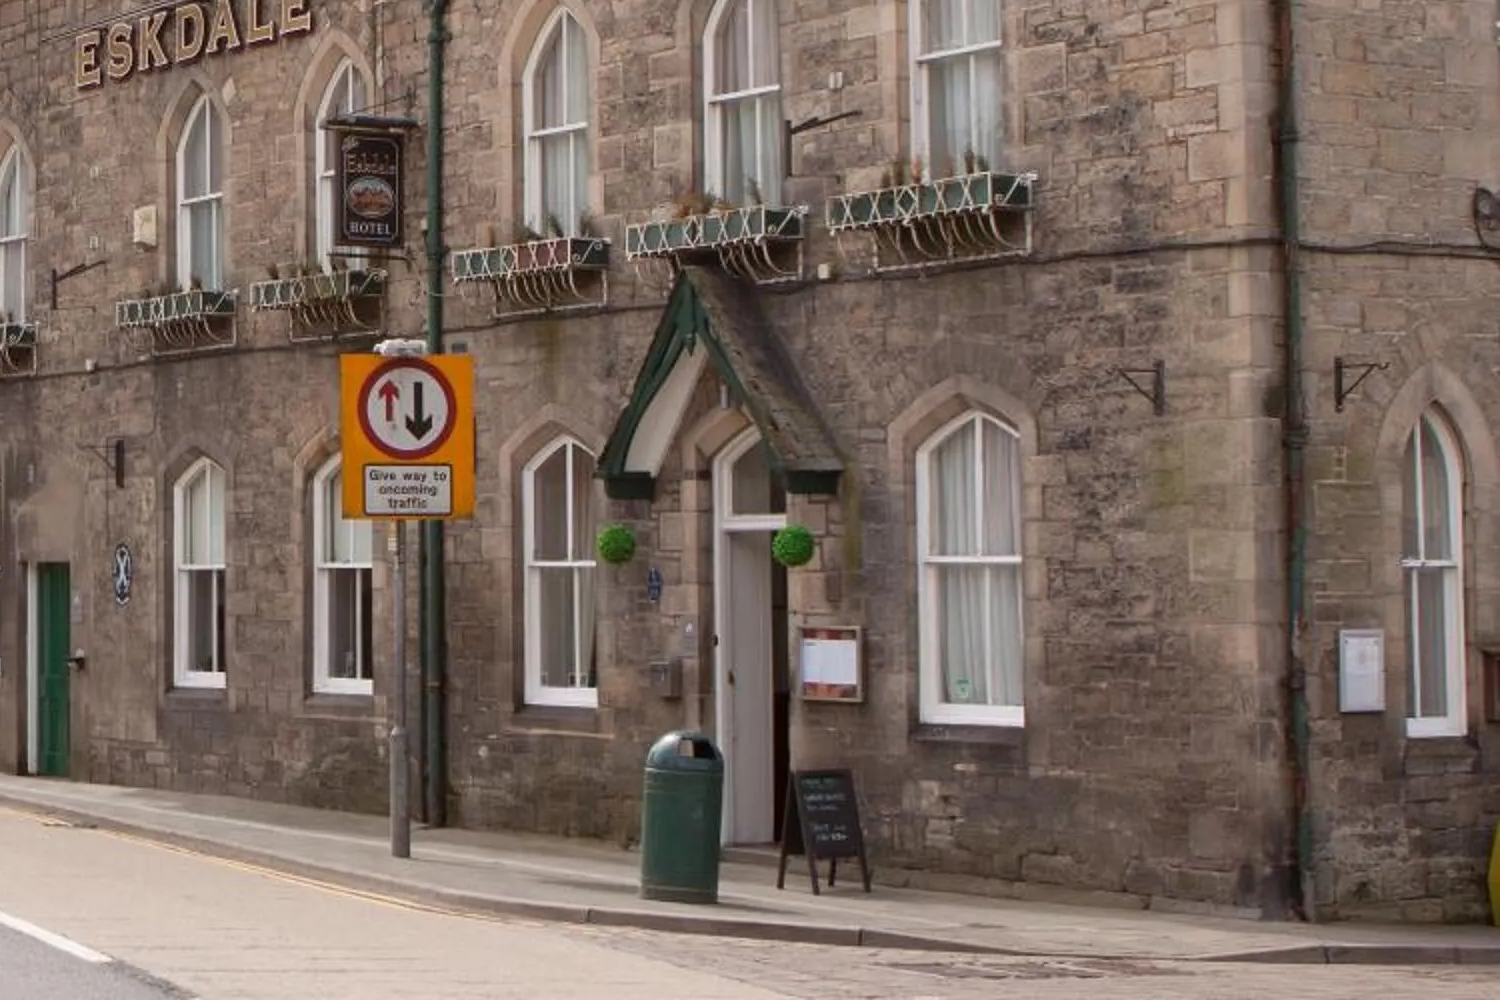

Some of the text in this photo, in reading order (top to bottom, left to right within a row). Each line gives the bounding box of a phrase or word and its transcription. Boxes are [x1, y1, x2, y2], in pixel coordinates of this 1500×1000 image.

[349, 221, 390, 234] HOTEL
[369, 469, 447, 482] Give way to
[379, 483, 437, 496] oncoming
[387, 497, 428, 509] traffic
